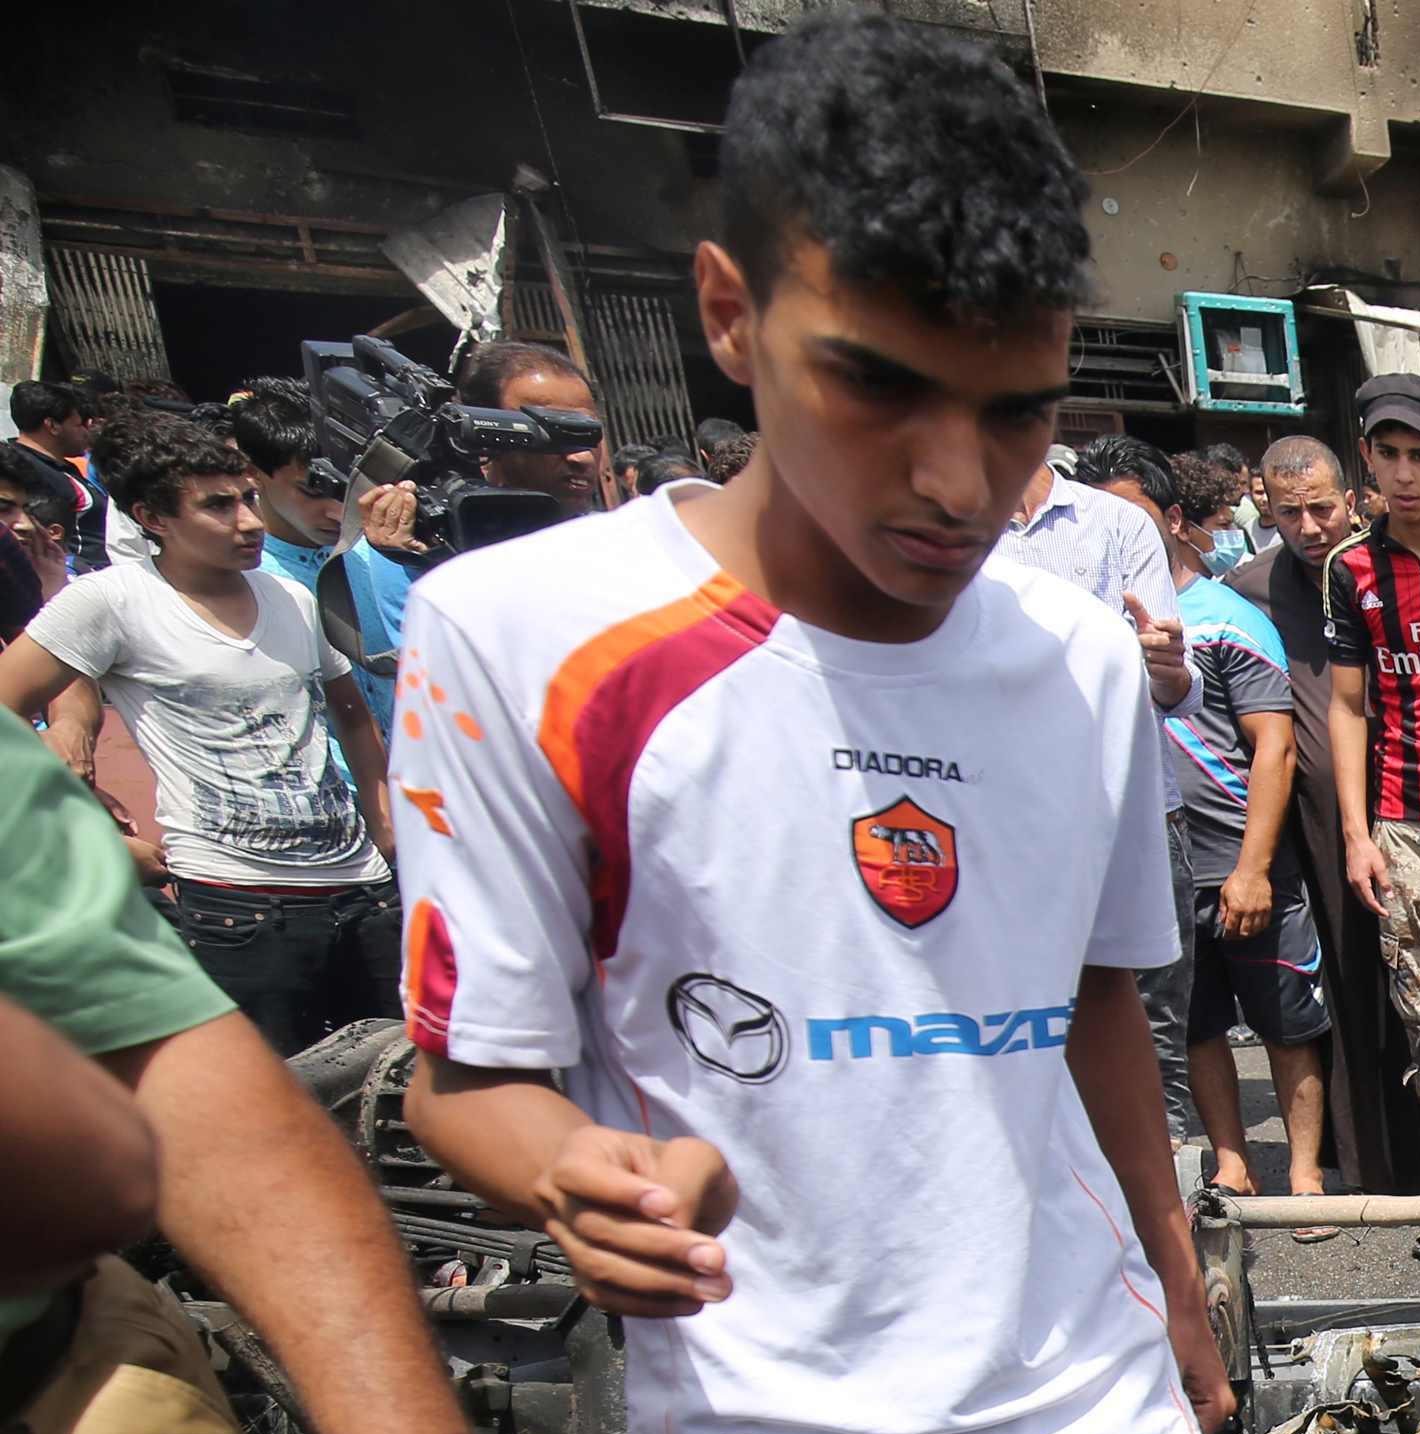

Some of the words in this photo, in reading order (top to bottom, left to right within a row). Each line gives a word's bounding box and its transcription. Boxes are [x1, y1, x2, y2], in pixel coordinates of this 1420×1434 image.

[473, 419, 500, 428] SONY
[832, 747, 963, 783] DIADORA
[806, 999, 1074, 1061] mazd
